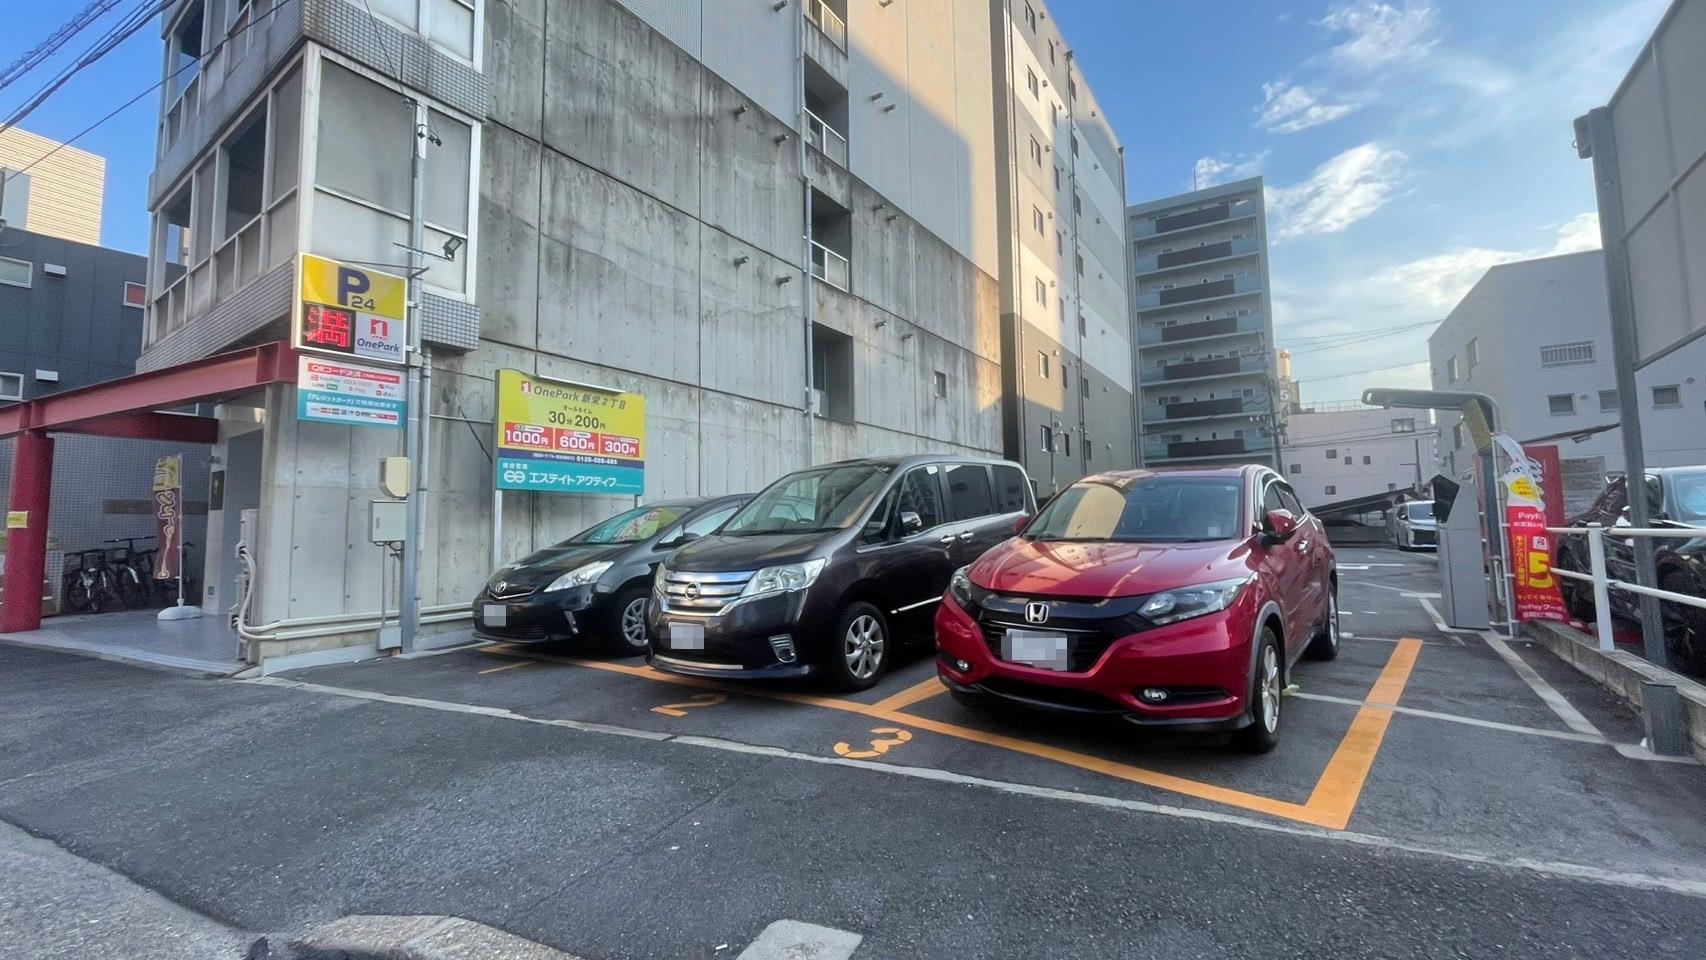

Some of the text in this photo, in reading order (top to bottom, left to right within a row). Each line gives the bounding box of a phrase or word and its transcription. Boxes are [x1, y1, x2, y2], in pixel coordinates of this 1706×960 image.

[338, 266, 370, 306] P
[352, 296, 376, 311] 24
[306, 306, 352, 349] 満
[357, 338, 400, 353] OnePark
[533, 385, 580, 401] OnePark
[505, 430, 549, 446] 1000円
[560, 435, 595, 450] 600円
[604, 441, 636, 455] 300円
[1529, 552, 1553, 588] 5
[833, 727, 912, 758] 3
